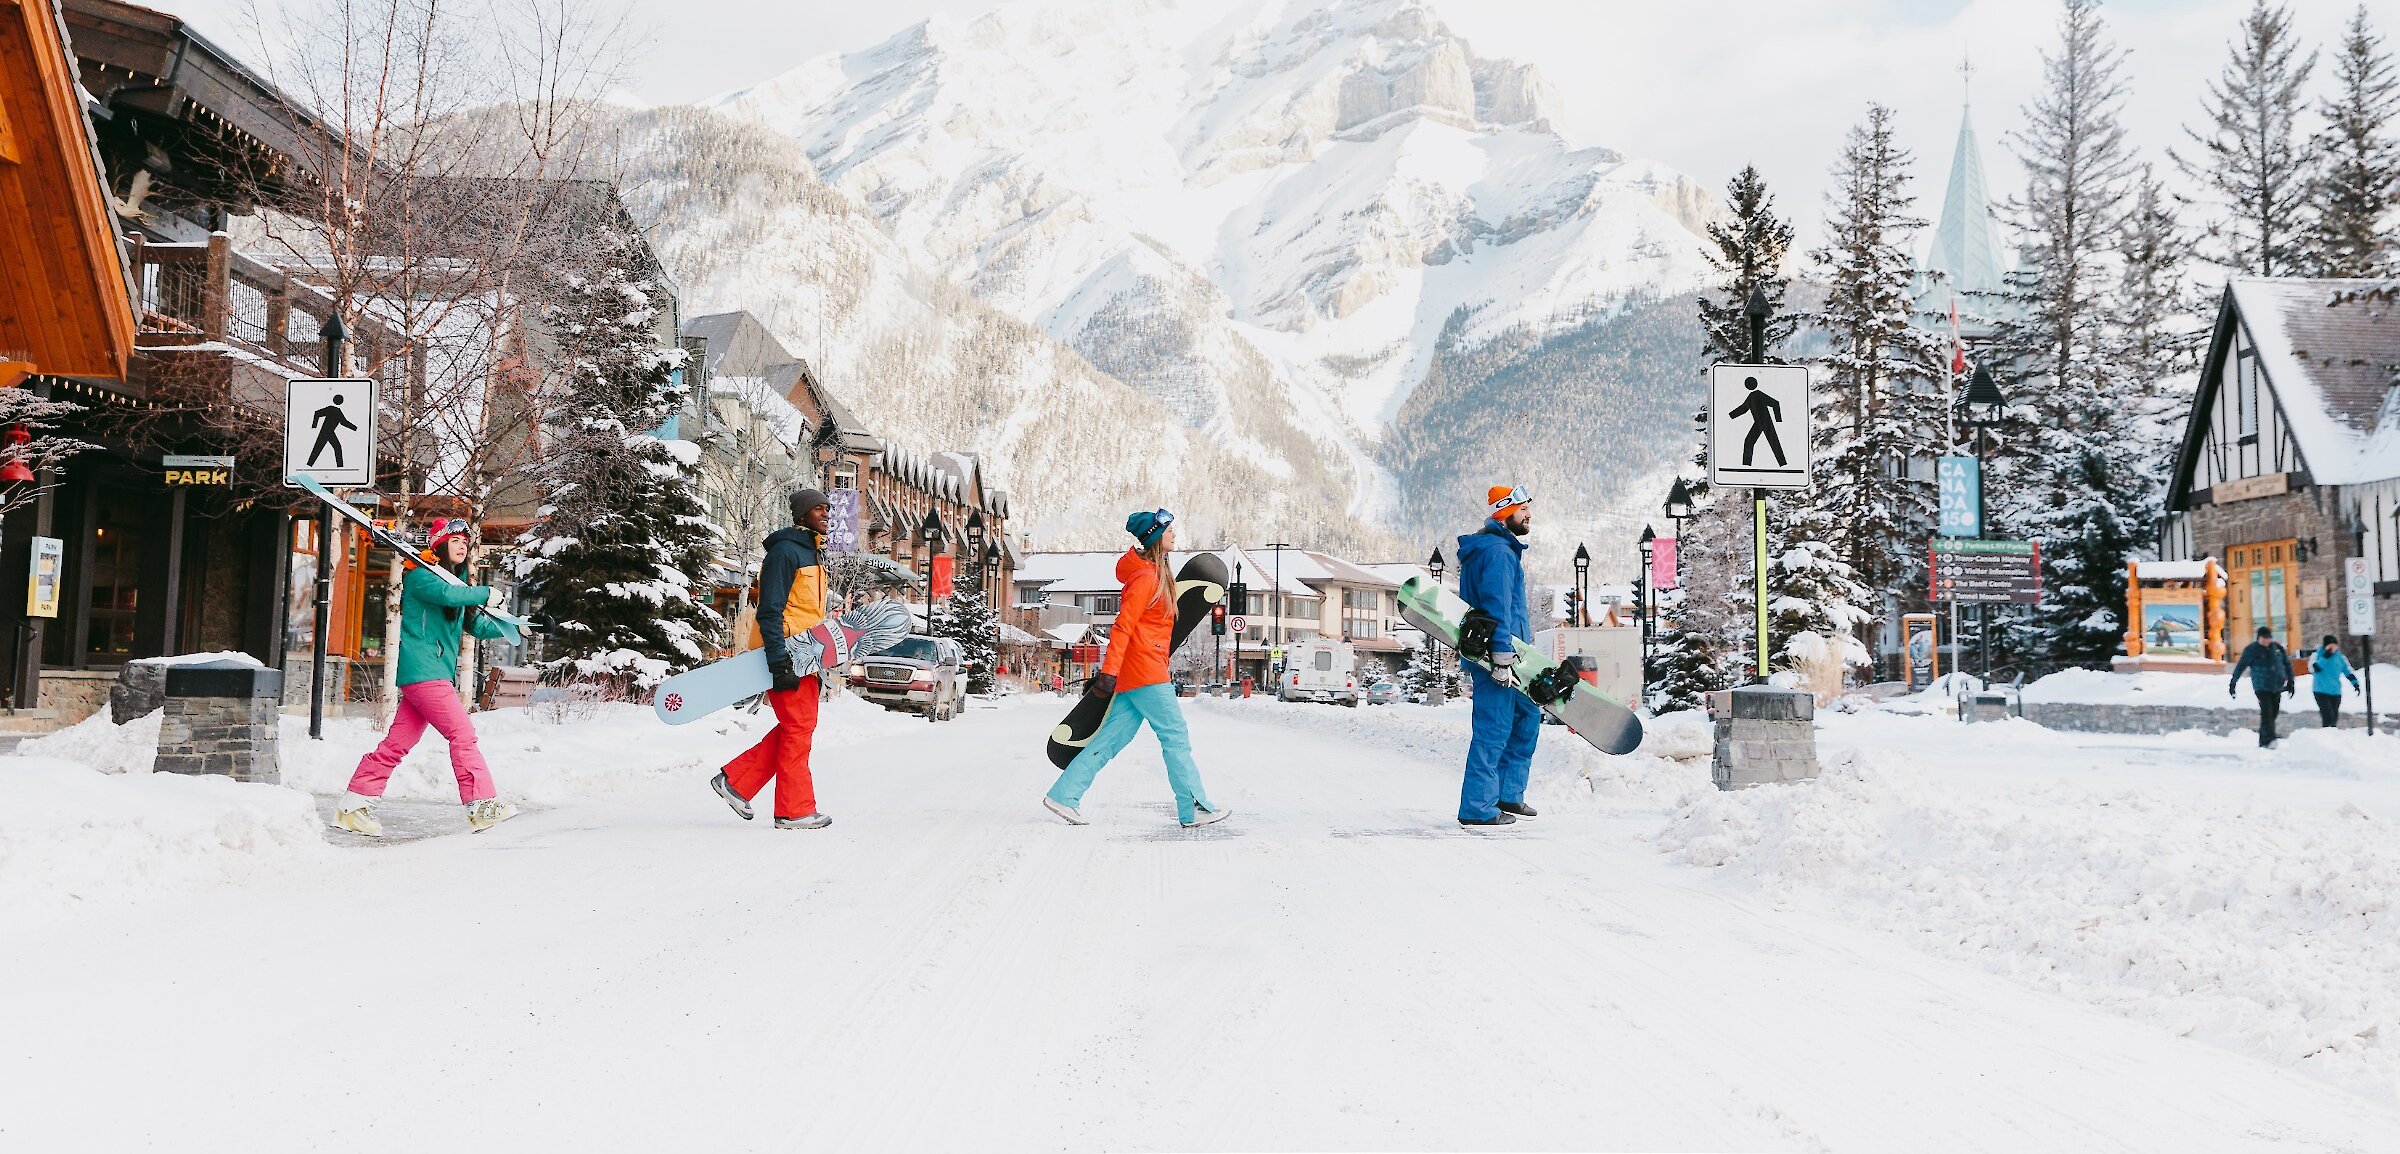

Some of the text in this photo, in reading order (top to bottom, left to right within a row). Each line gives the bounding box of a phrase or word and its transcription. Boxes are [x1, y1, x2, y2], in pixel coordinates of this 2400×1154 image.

[1938, 462, 1966, 477] CA
[164, 470, 228, 485] PARK
[1939, 478, 1967, 494] NA
[828, 493, 849, 505] CA
[1939, 495, 1968, 510] DA
[1941, 511, 1975, 527] 150
[867, 558, 894, 573] SHOPS
